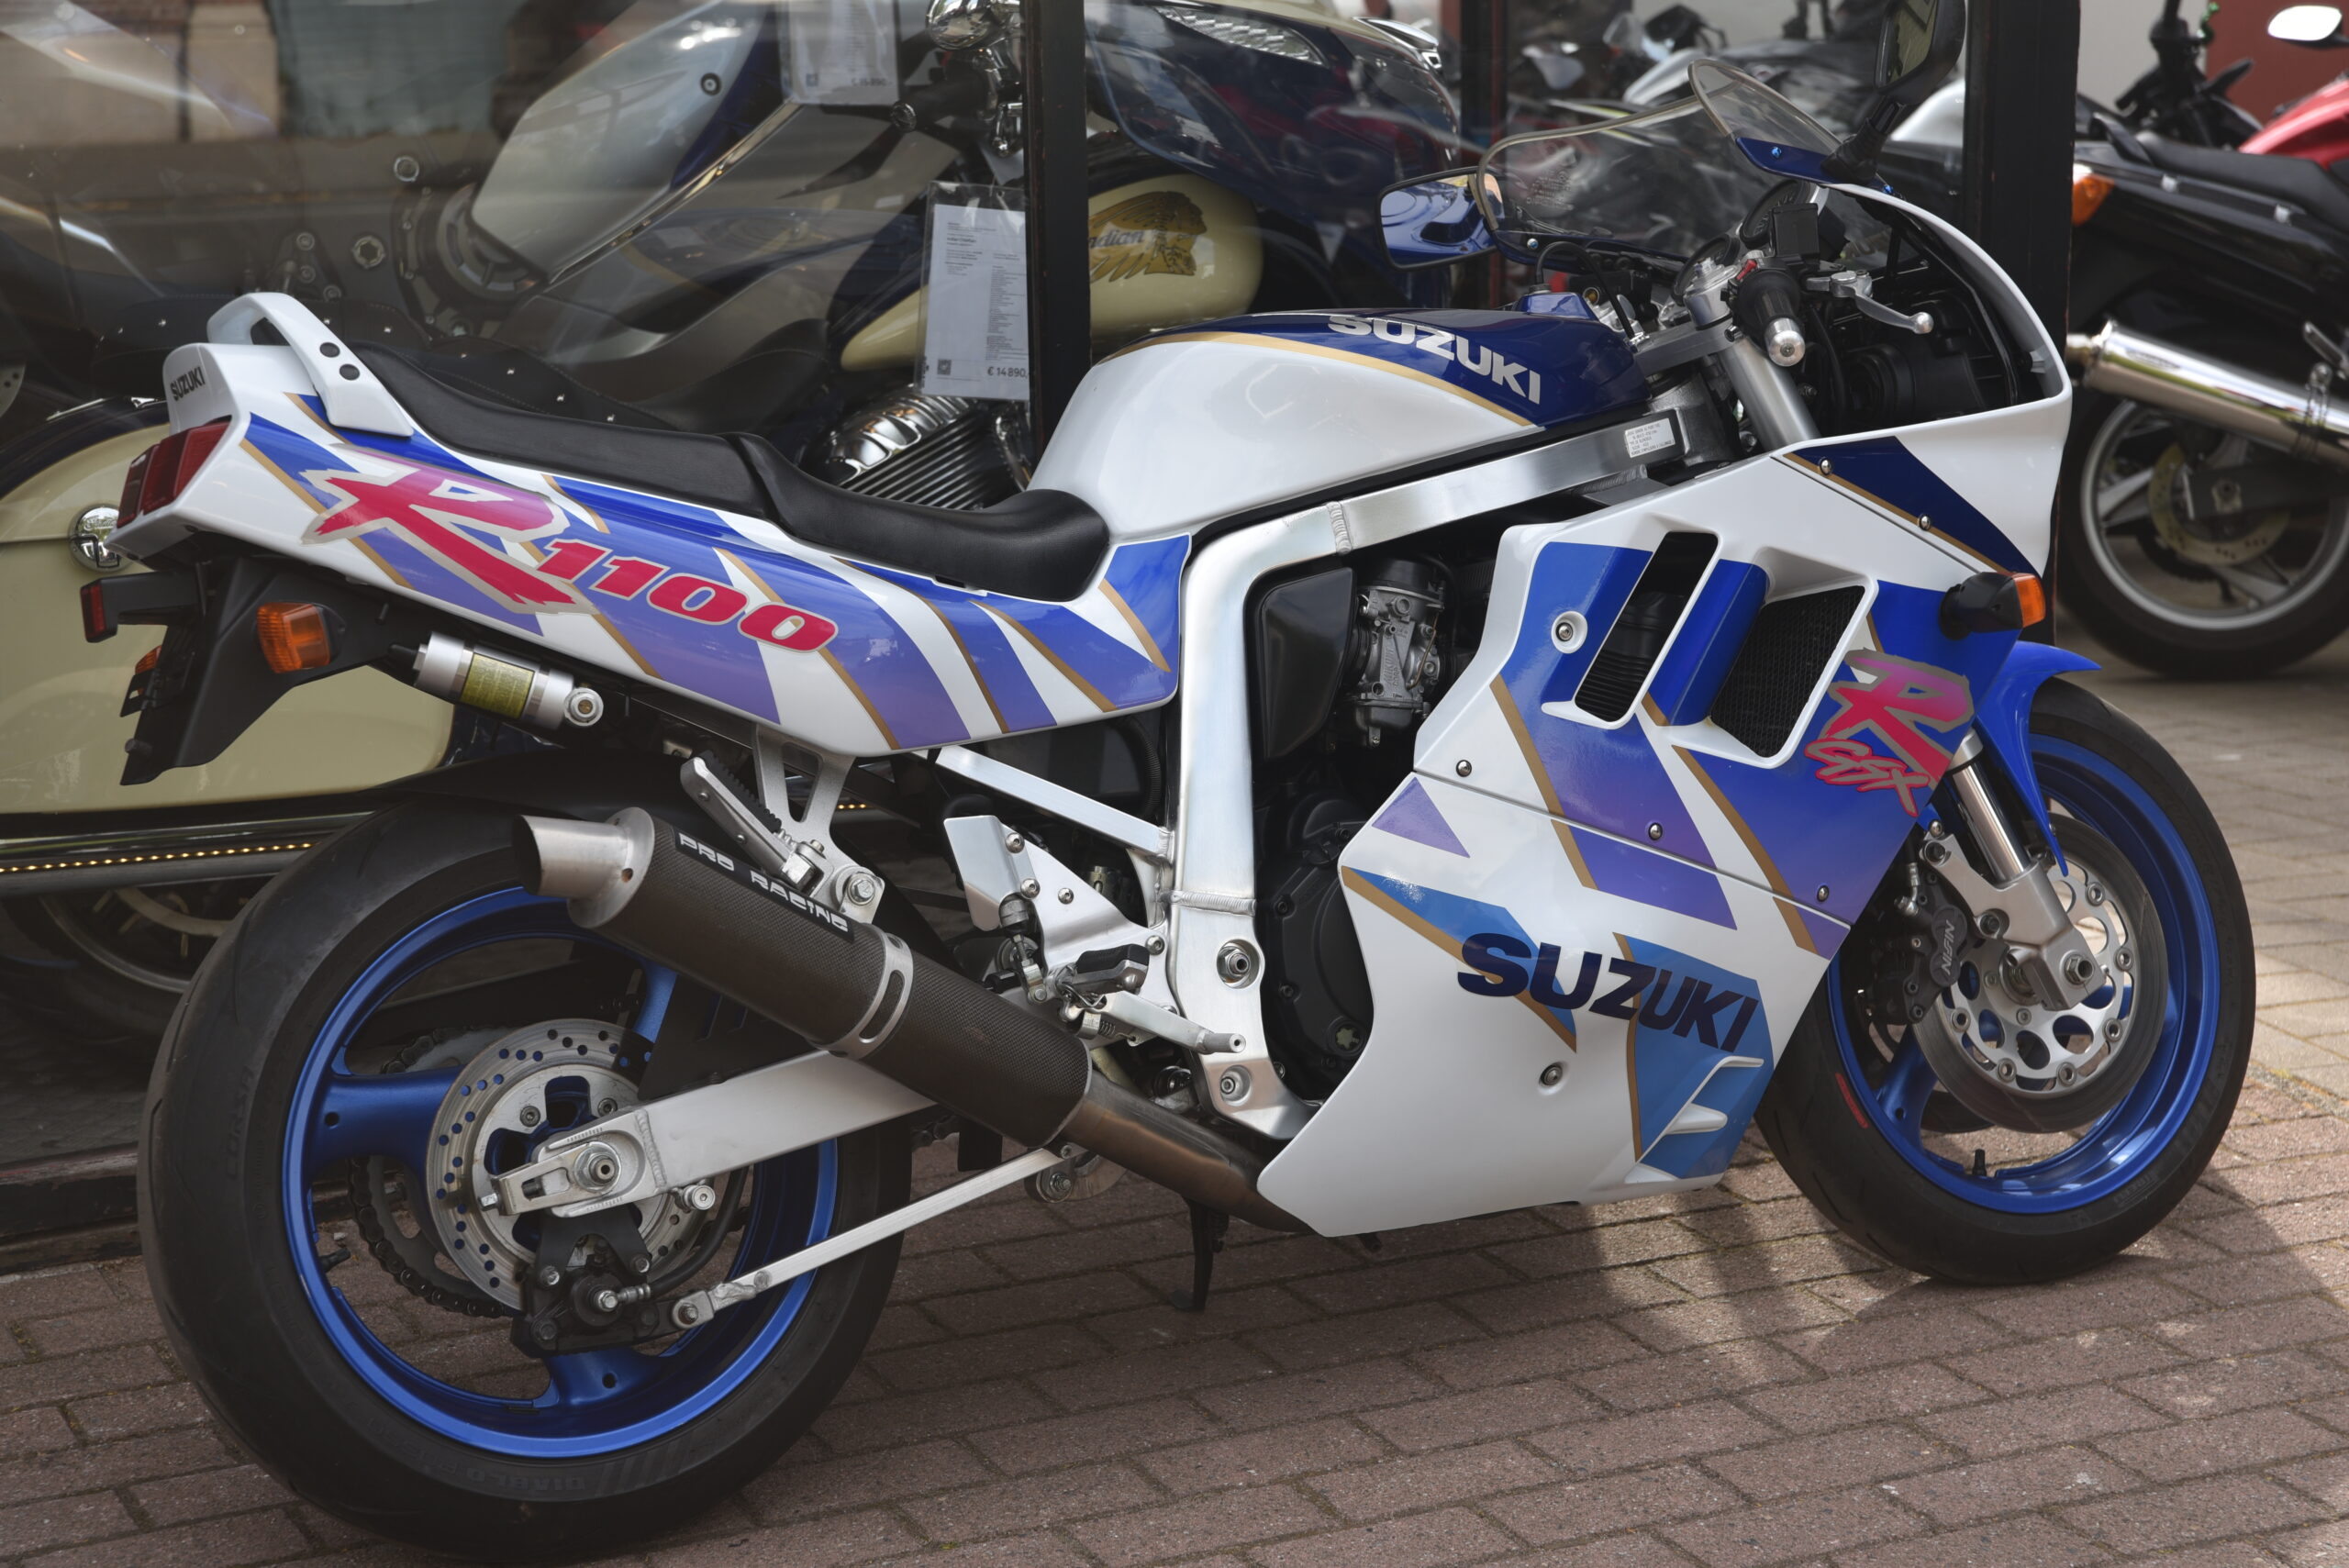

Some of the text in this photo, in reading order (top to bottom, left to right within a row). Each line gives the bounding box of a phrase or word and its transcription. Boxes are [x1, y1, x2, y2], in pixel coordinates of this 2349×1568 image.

[1088, 228, 1145, 250] ndian
[169, 366, 206, 402] SUZUKI
[1328, 315, 1542, 405] SUZUKI
[534, 539, 839, 653] 1100
[1804, 737, 1932, 817] GSX
[678, 832, 850, 933] PRO RACING
[1941, 919, 1955, 976] NISSIN
[1457, 932, 1759, 1053] SUZUKI
